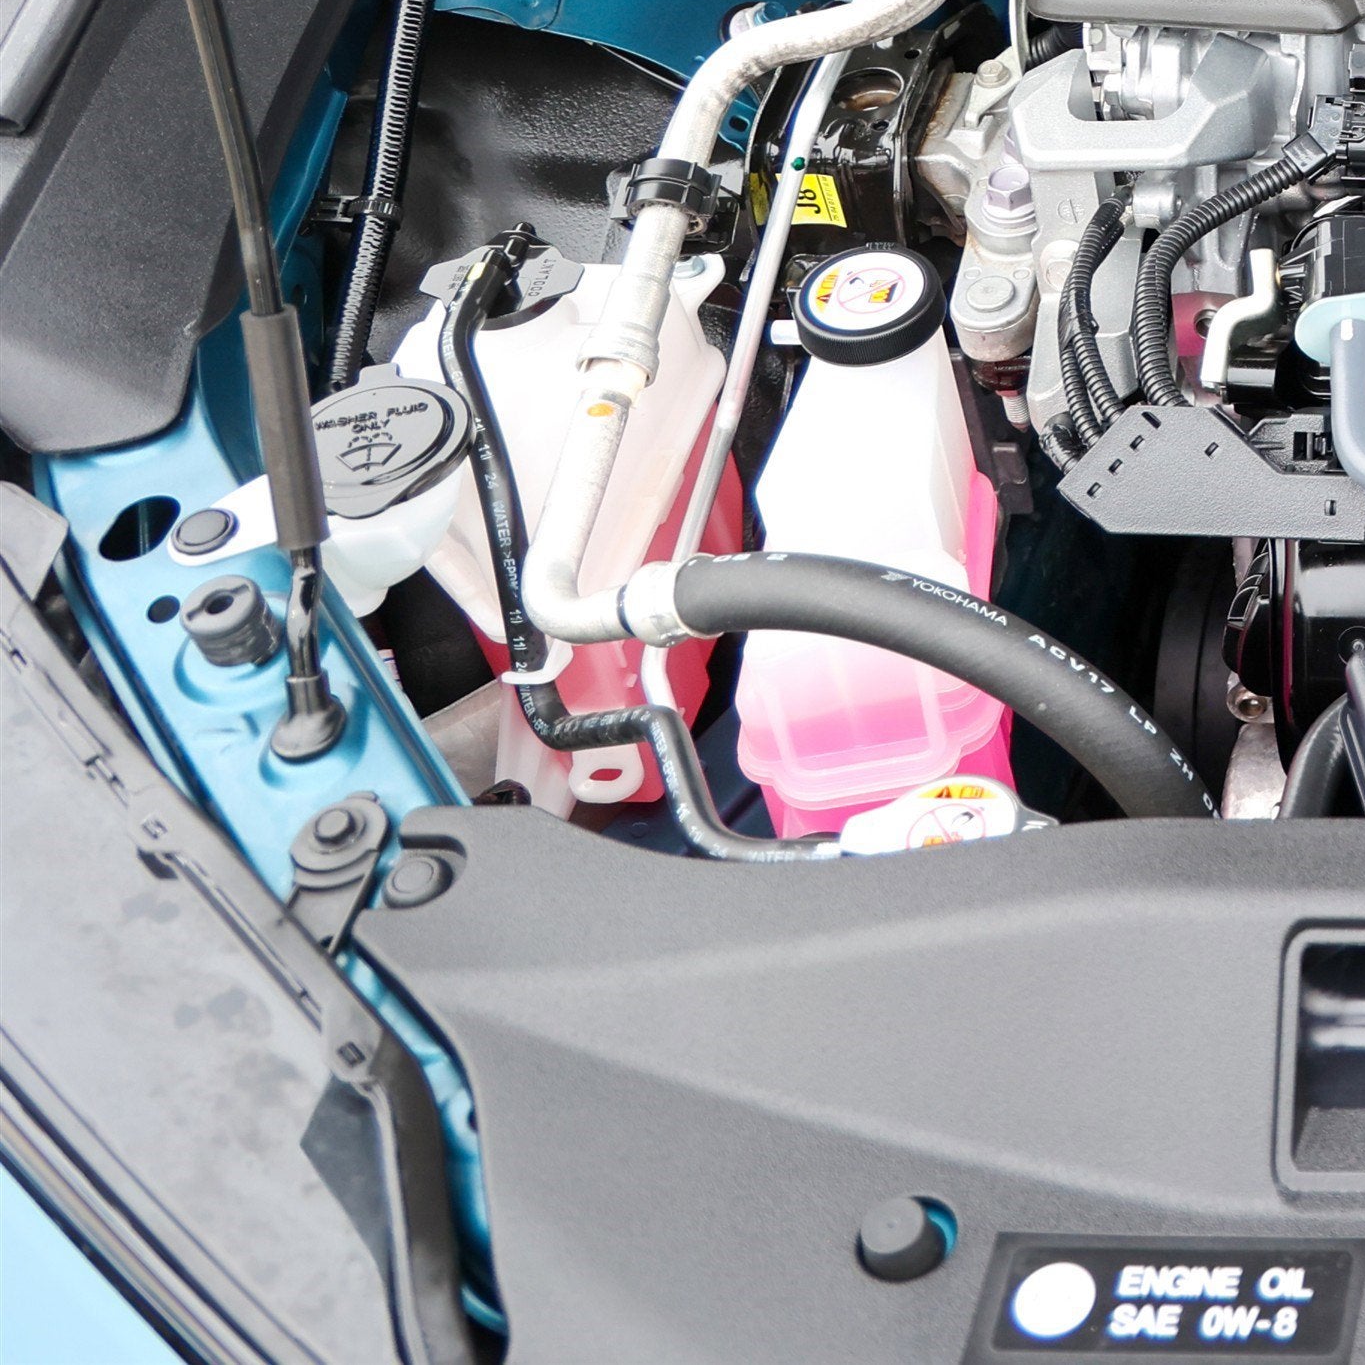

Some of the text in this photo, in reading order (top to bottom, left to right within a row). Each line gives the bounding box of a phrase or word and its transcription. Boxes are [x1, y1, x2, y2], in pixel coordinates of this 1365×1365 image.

[528, 259, 557, 298] COOLANT
[315, 402, 429, 431] WASHER FLUID
[352, 418, 391, 434] ONLY
[491, 500, 513, 547] WATER
[911, 577, 1009, 628] YOKOHAMA
[1129, 705, 1159, 736] LP
[1169, 747, 1195, 782] ZH
[1114, 1265, 1315, 1302] ENGINE OIL
[1107, 1304, 1299, 1342] SAE 0W-8
